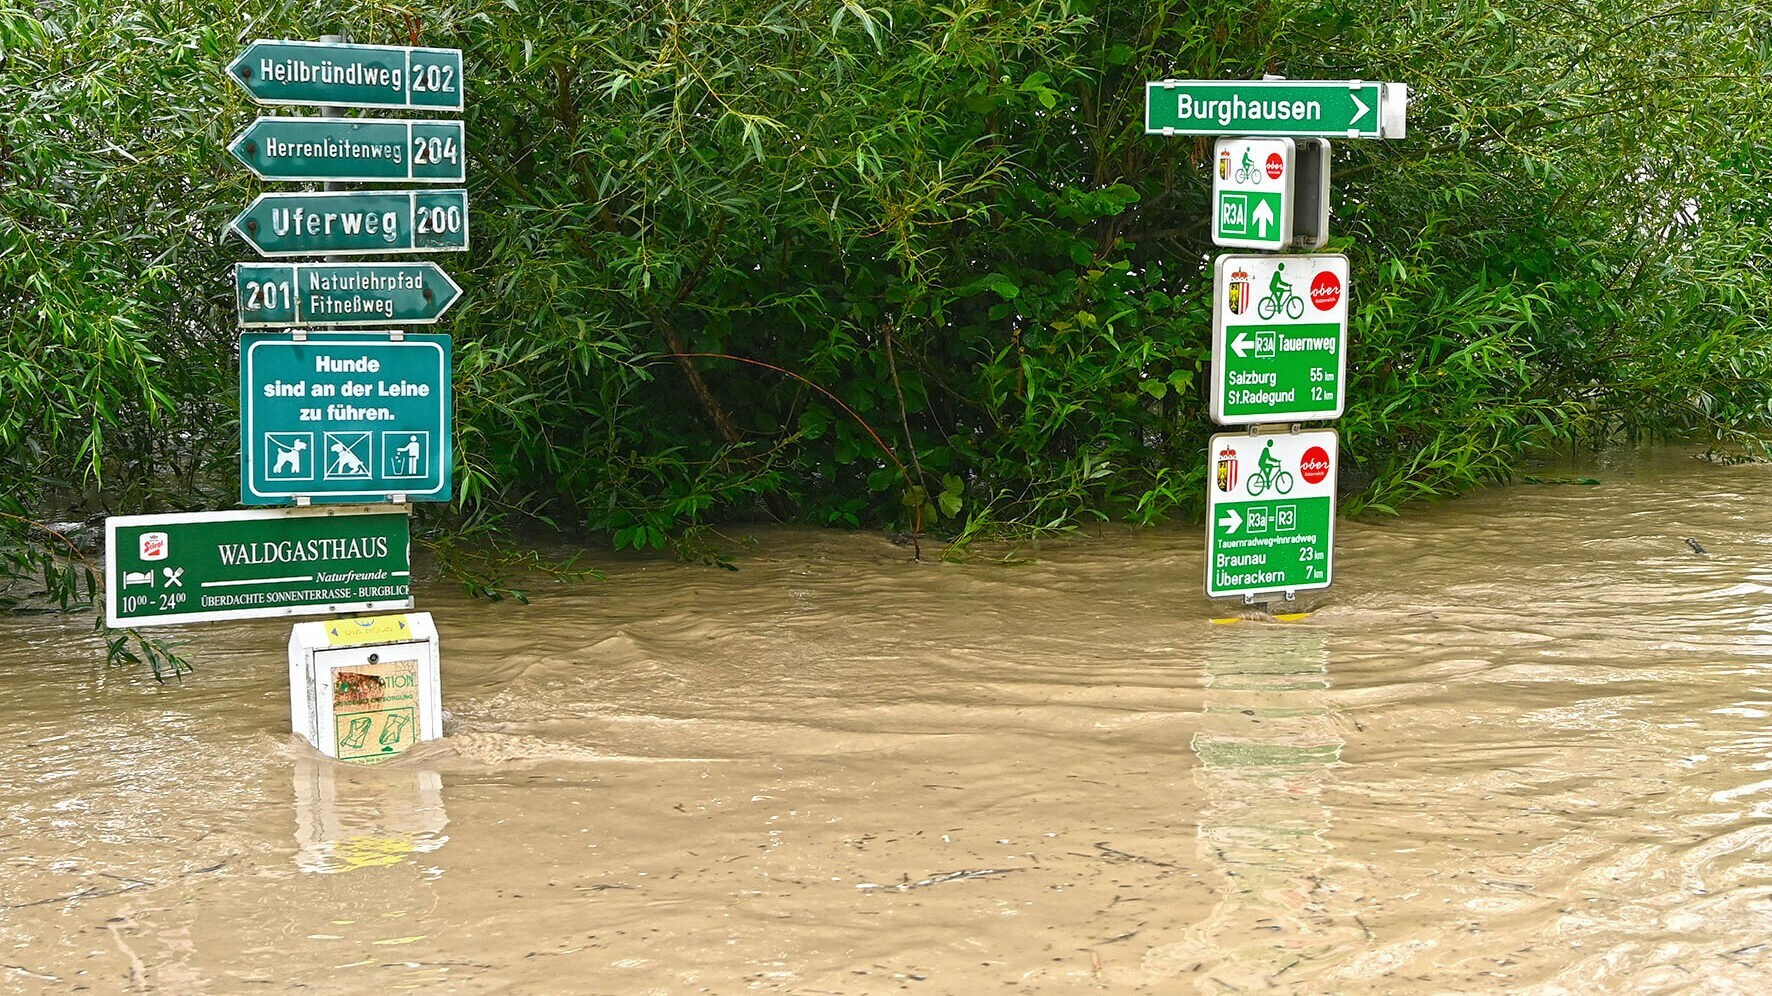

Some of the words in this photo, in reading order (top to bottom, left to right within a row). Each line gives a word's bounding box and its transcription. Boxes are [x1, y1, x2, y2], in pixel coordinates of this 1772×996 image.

[260, 58, 402, 92] Heilbründlweg
[412, 64, 455, 93] 202
[1177, 93, 1321, 126] Burghausen
[266, 137, 402, 164] Herrenleitenweg
[413, 137, 458, 165] 204
[271, 207, 397, 243] Uferweg
[416, 205, 461, 234] 200
[1222, 202, 1244, 225] R3A
[309, 271, 423, 292] Naturlehrpfad
[245, 281, 291, 311] 201
[310, 296, 393, 317] Fitneßweg
[1255, 338, 1275, 352] R3A
[1278, 334, 1336, 354] Tauernweg
[315, 355, 381, 373] Hunde
[1228, 370, 1277, 387] Salzburg
[1310, 367, 1323, 382] 55
[1324, 372, 1335, 381] km
[263, 380, 306, 397] sind
[311, 383, 336, 397] an
[340, 380, 373, 397] der
[378, 380, 430, 397] Leine
[1228, 388, 1295, 406] St.Radegund
[1311, 386, 1322, 401] 12
[1323, 390, 1334, 400] km
[299, 407, 322, 421] zu
[327, 404, 395, 421] führen.
[1248, 512, 1266, 527] R3a
[1278, 511, 1294, 526] R3
[217, 536, 388, 566] WALDGASTHAUS
[1216, 552, 1266, 568] Braunau
[1299, 547, 1314, 562] 23
[1314, 550, 1325, 560] km
[315, 568, 388, 584] Naturfreunde
[1215, 569, 1285, 587] Überackern
[1306, 565, 1314, 580] 7
[1314, 569, 1324, 579] km
[201, 592, 265, 608] ÜBERDACHTE
[266, 587, 351, 603] SONNENTERRASSE
